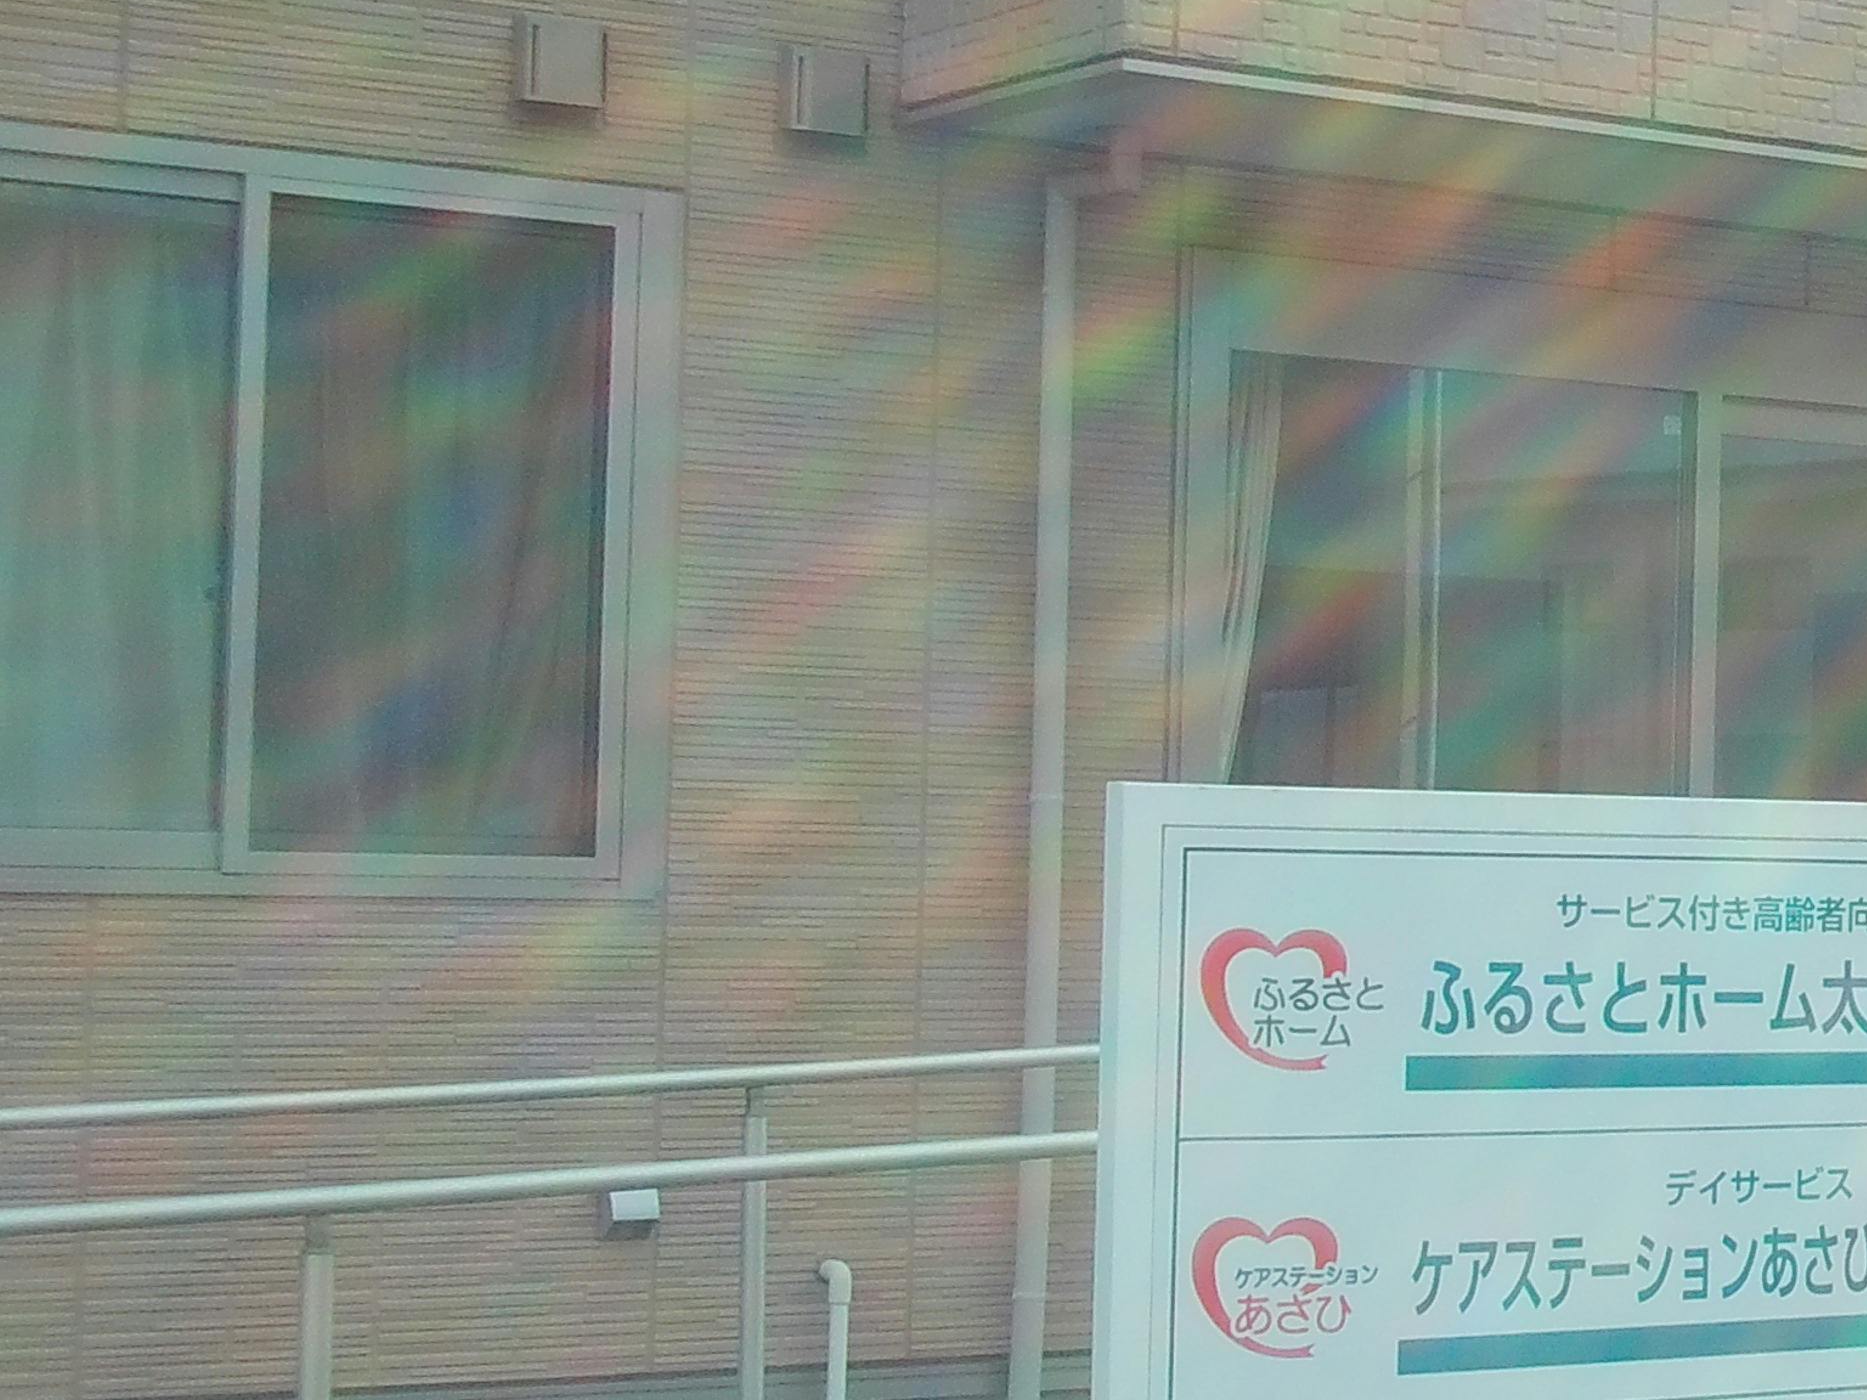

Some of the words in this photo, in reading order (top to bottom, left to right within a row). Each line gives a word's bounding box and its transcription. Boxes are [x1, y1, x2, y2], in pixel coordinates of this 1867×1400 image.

[1253, 977, 1385, 1012] ふるさと
[1253, 1014, 1352, 1048] ホーム
[1665, 1167, 1854, 1206] デイサービス
[1235, 1264, 1379, 1290] ケアステーション
[1235, 1293, 1353, 1336] あさひ
